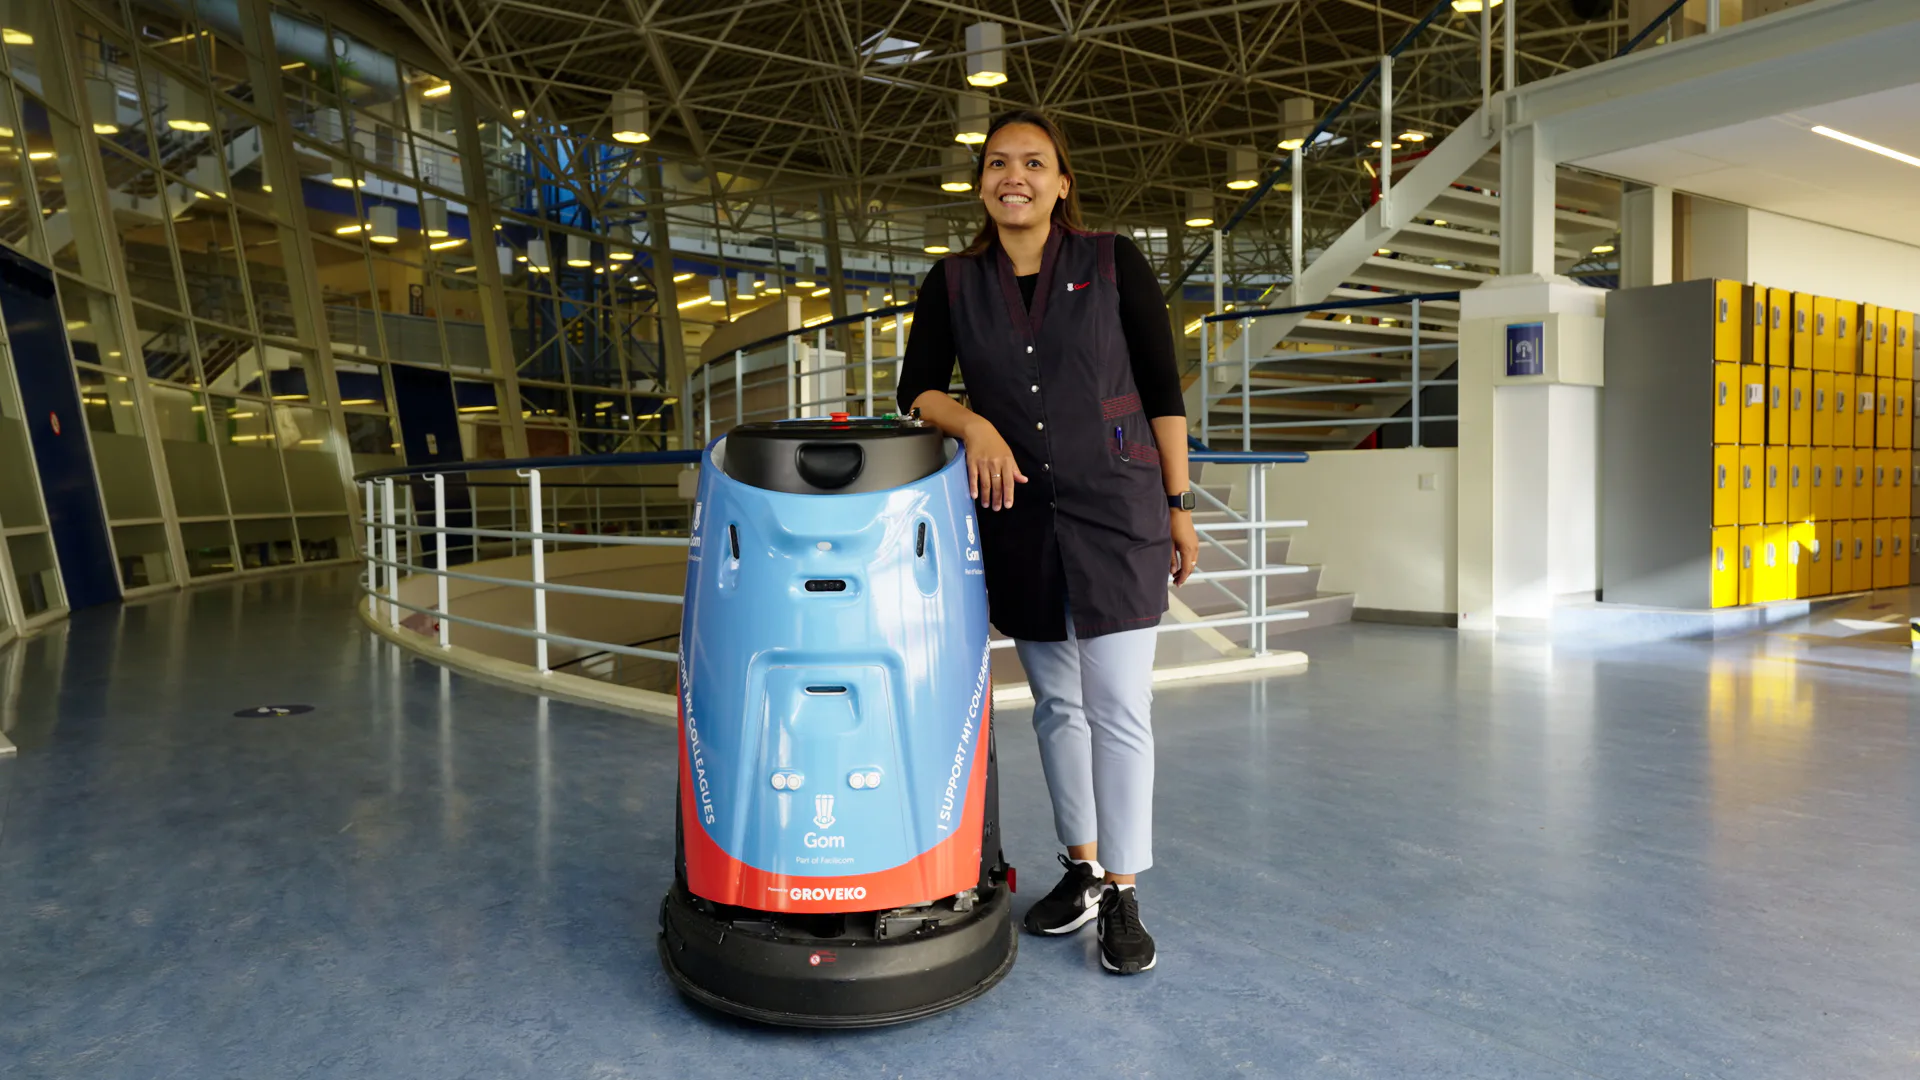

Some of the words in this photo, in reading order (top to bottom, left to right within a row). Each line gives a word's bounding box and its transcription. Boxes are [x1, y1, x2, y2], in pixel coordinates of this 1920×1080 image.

[685, 691, 694, 714] MY
[961, 717, 973, 744] MY
[689, 717, 715, 825] COLLEAGUES
[939, 742, 967, 821] SUPPORT
[937, 823, 948, 831] I
[803, 831, 845, 849] Gom
[796, 856, 810, 864] Part
[811, 856, 818, 864] of
[790, 886, 867, 901] GROVEKO
